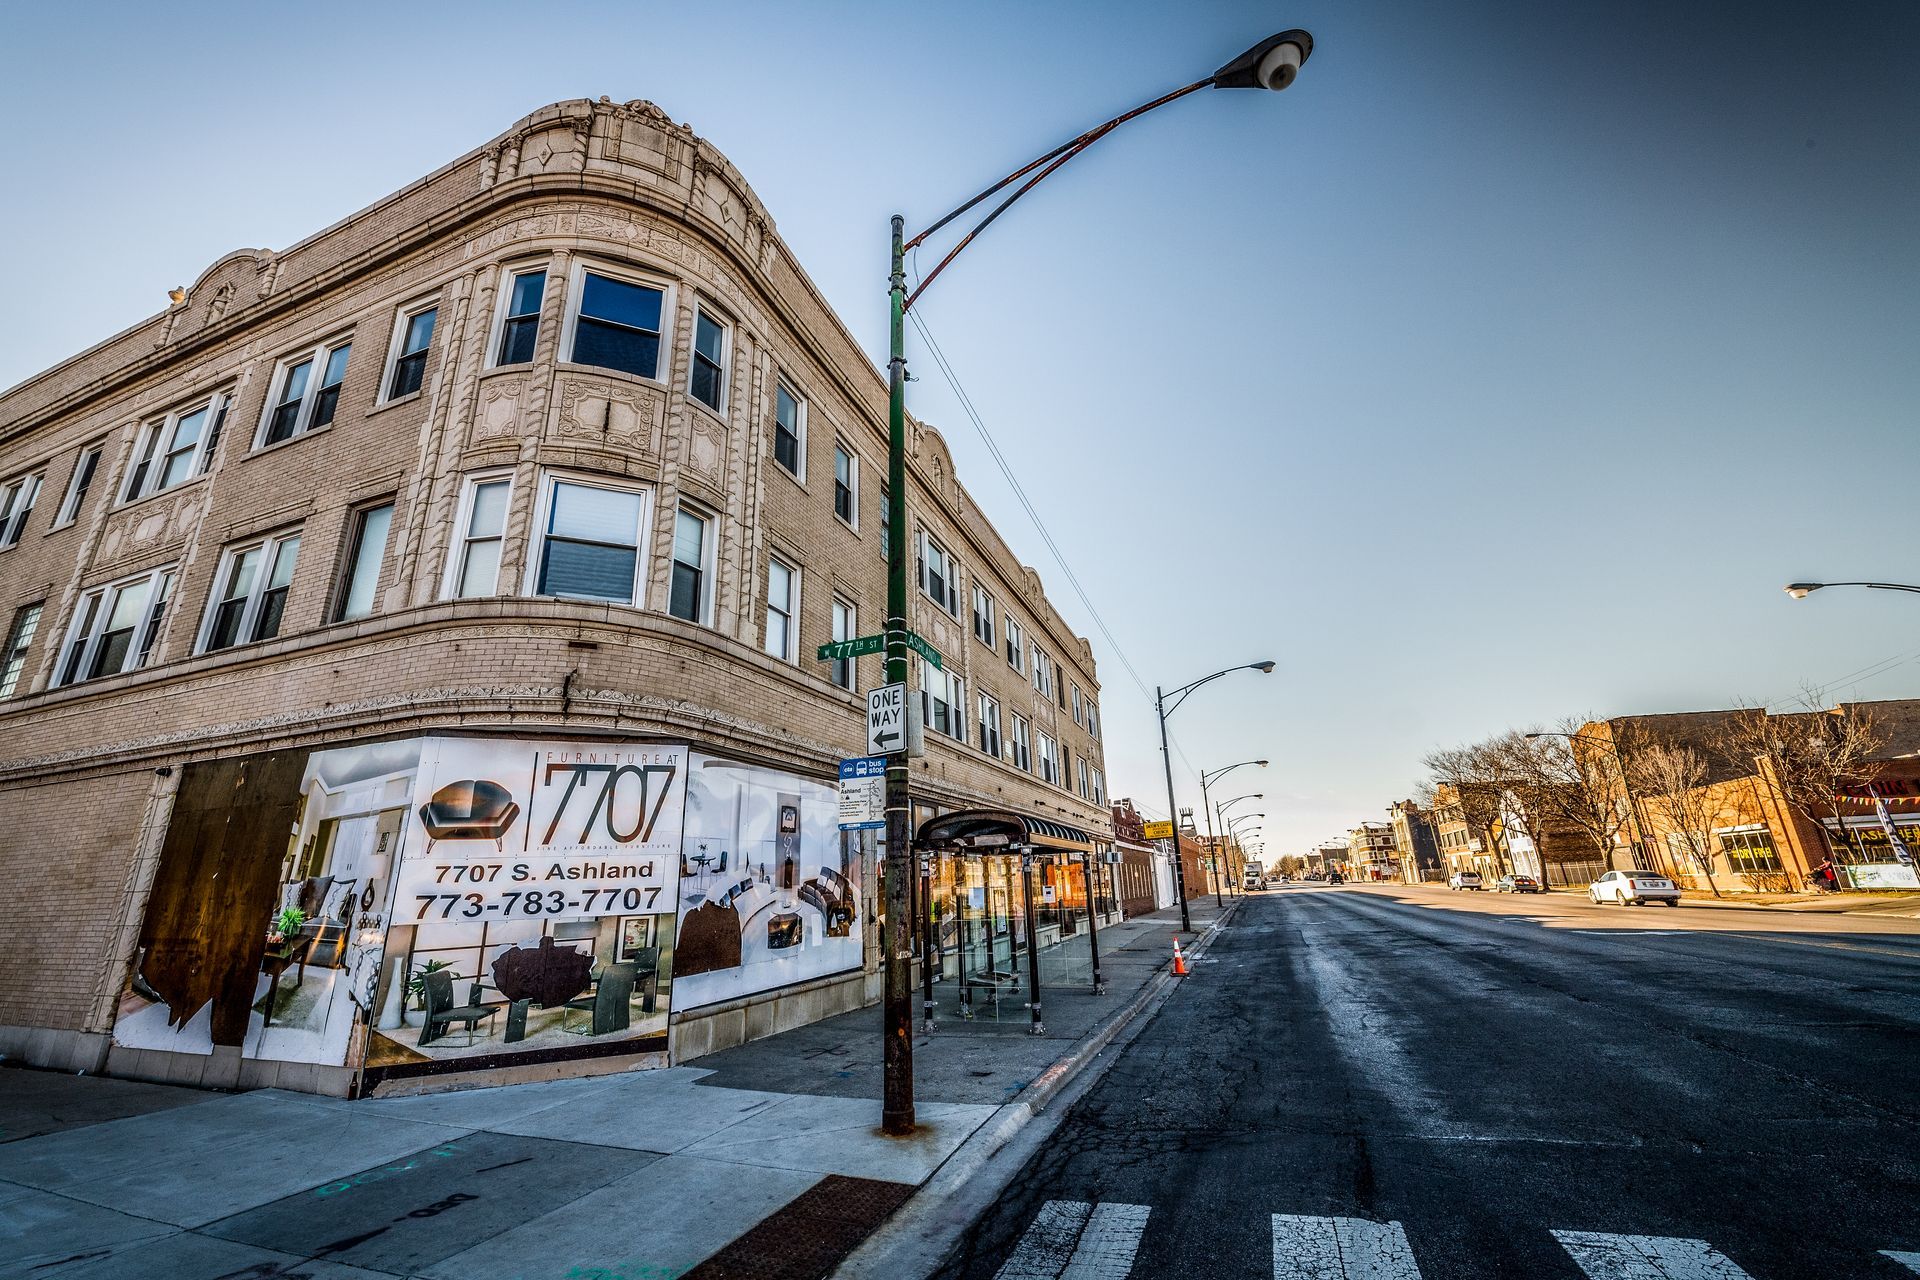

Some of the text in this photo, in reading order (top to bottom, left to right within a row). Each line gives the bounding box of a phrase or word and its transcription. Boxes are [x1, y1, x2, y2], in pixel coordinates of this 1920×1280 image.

[869, 640, 878, 649] ST
[908, 634, 937, 664] ASHLAND
[872, 690, 900, 709] ONE
[871, 708, 900, 728] WAY
[547, 752, 679, 765] FURNITURE AT
[541, 763, 676, 845] 7707
[435, 861, 653, 884] 7707 S. Ashland
[415, 886, 661, 919] 773-783-7707
